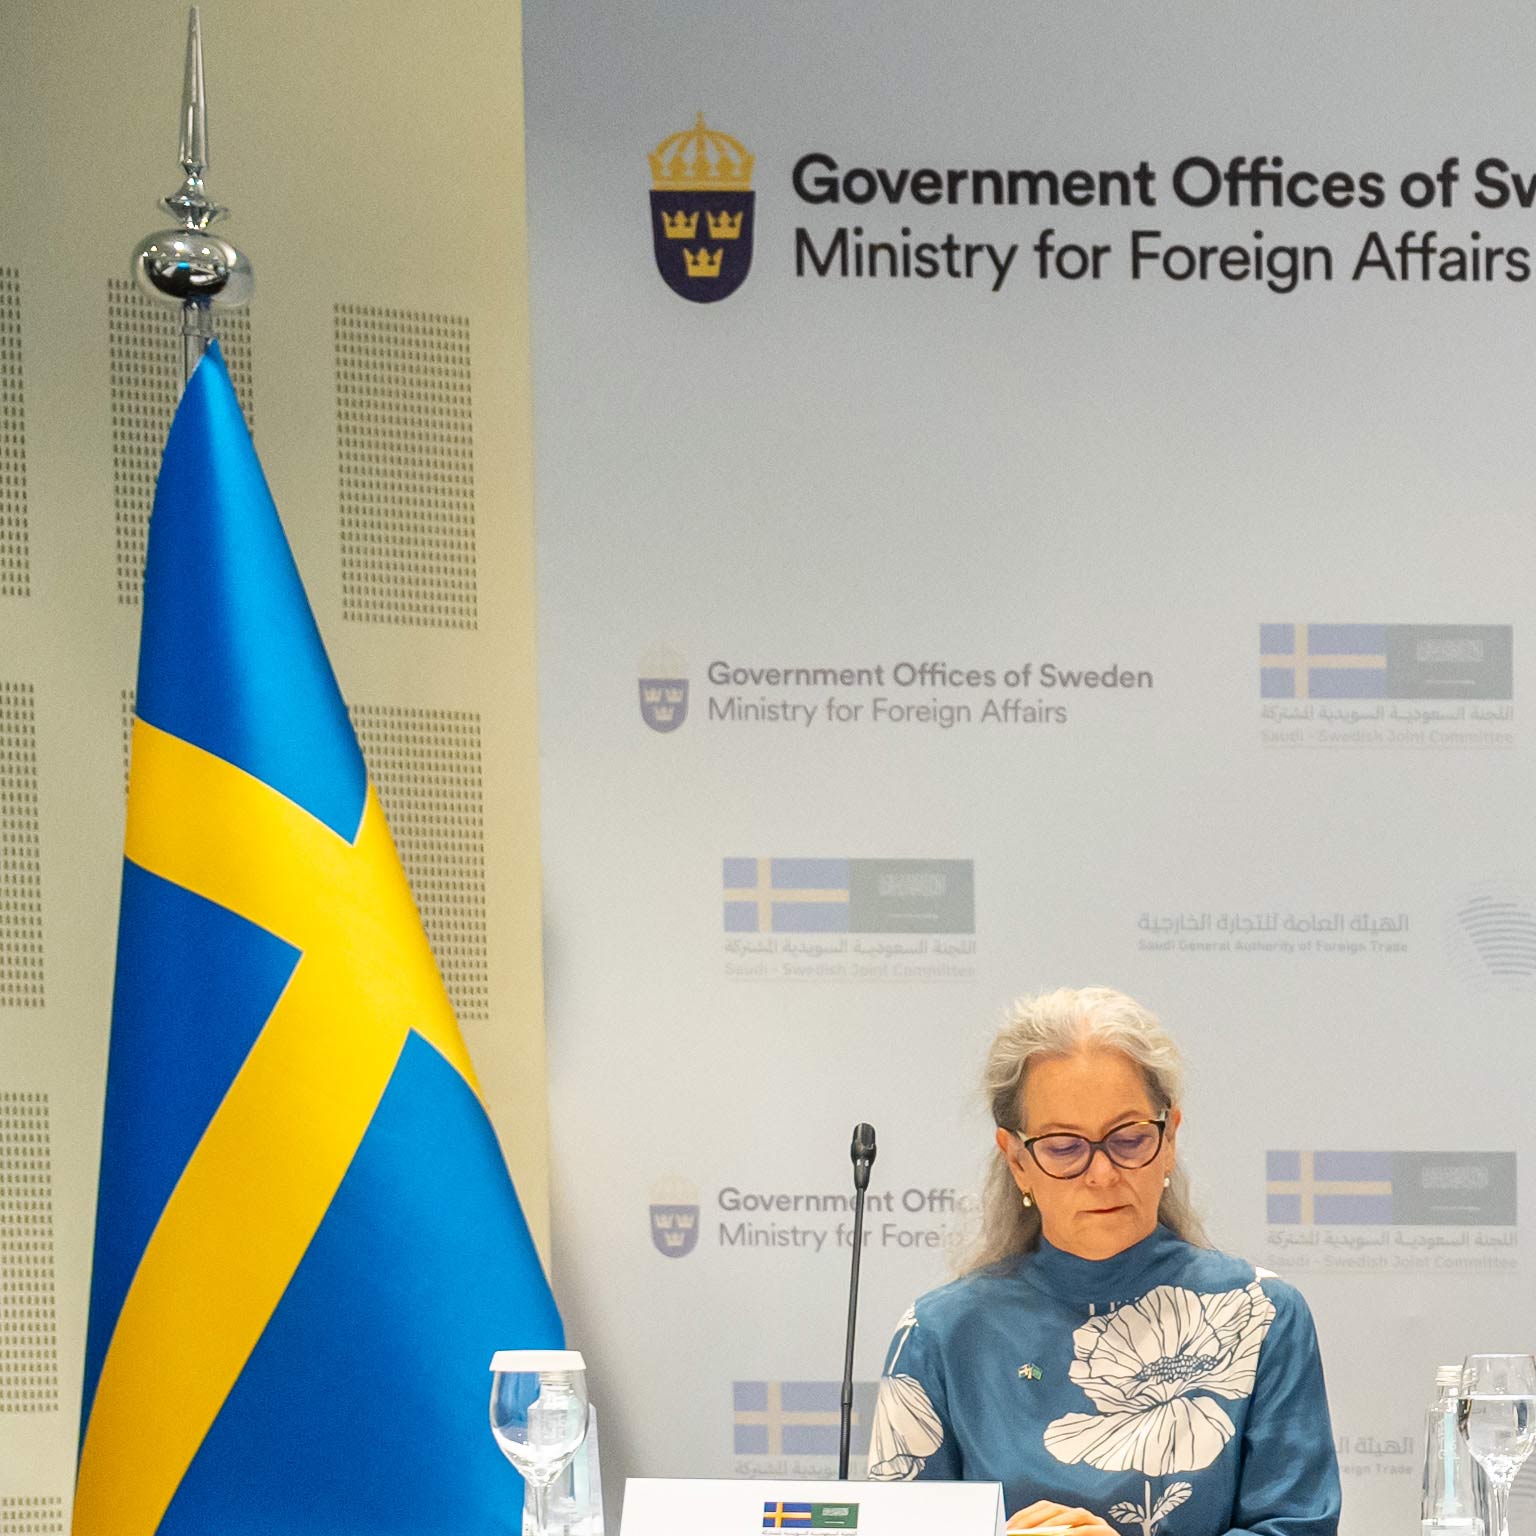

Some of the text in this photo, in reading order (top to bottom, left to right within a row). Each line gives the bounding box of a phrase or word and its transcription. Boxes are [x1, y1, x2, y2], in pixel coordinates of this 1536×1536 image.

[791, 151, 1157, 208] Government
[1171, 154, 1387, 210] Offices
[1399, 155, 1461, 210] of
[794, 225, 1532, 296] Ministry for Foreign Affairs
[707, 660, 1154, 689] Government Offices of Sweden
[708, 696, 1068, 730] Ministry for Foreign Affairs
[901, 1187, 969, 1213] Offi
[718, 1222, 828, 1253] Ministry
